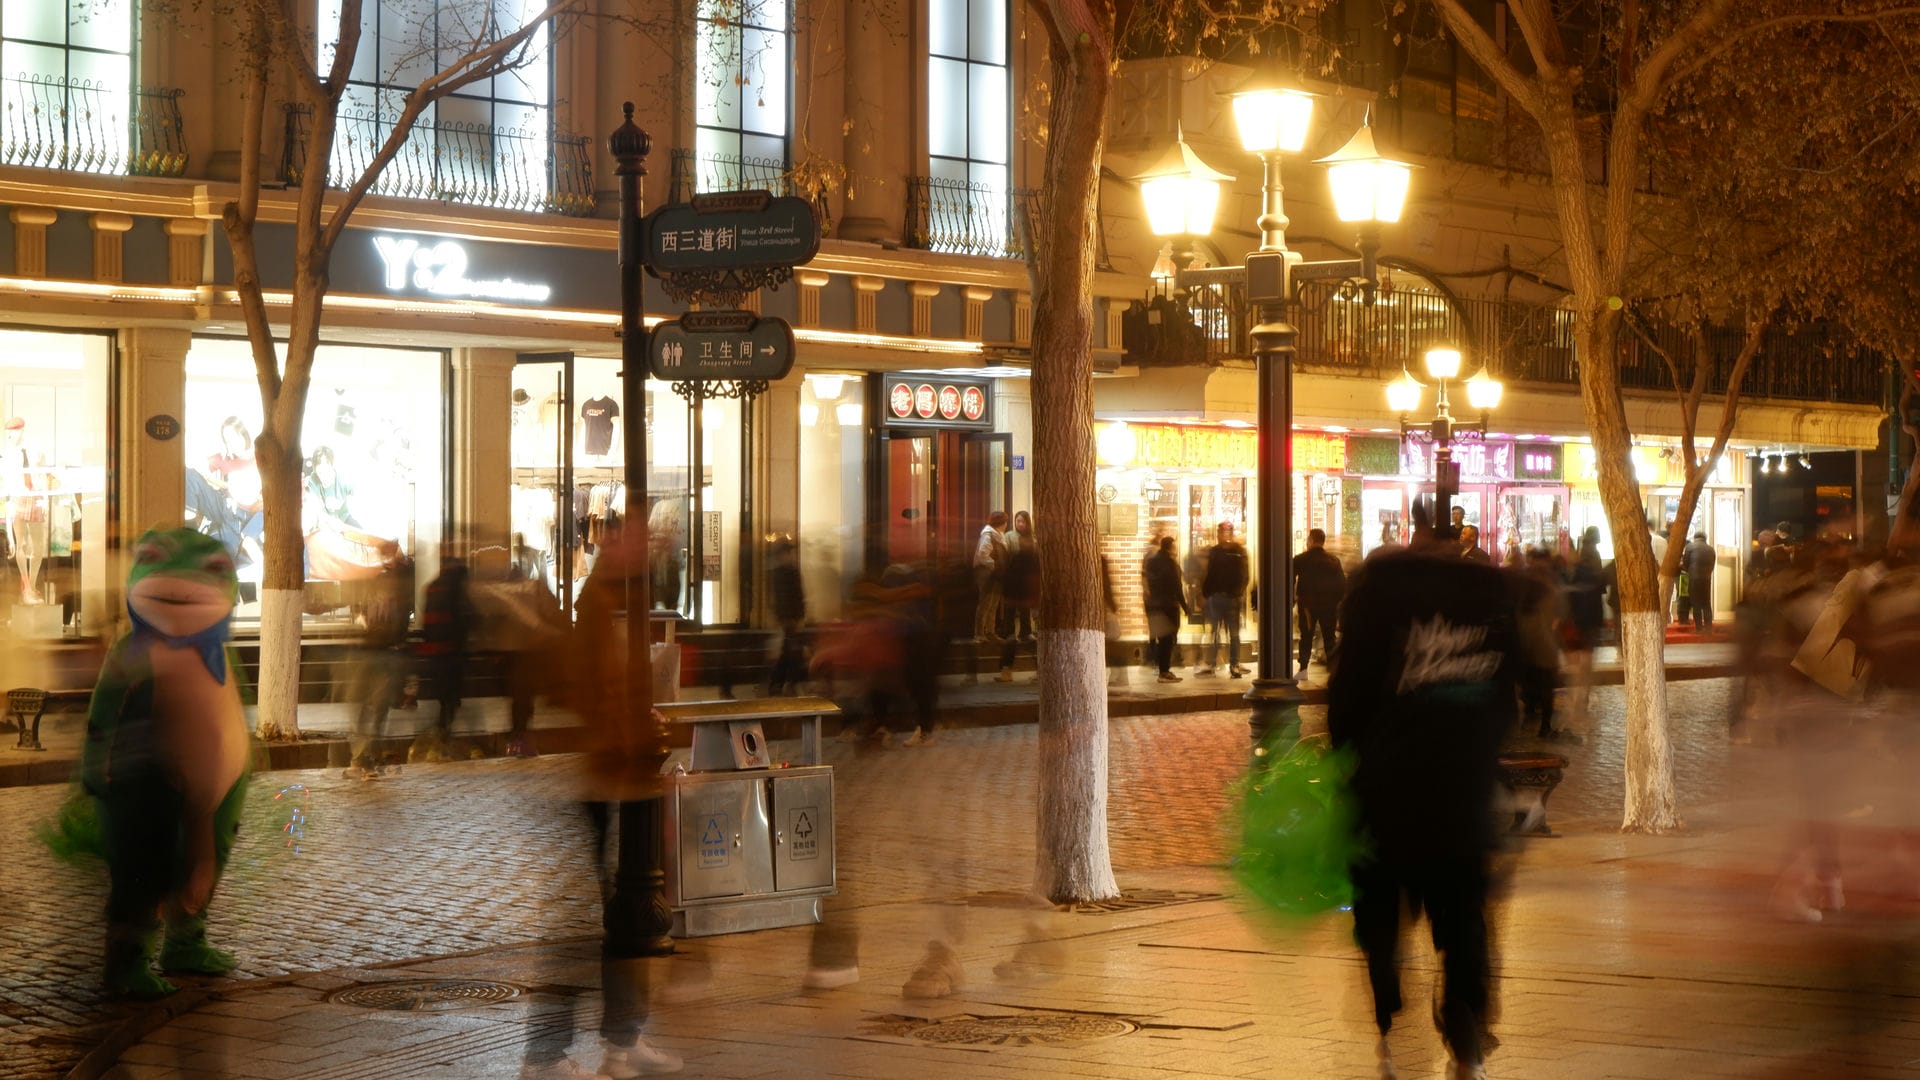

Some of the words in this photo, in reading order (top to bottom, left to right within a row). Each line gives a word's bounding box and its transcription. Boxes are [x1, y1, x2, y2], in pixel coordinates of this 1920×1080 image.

[759, 226, 773, 235] 3rd
[661, 228, 734, 253] 西三道街
[700, 340, 753, 359] 卫生间
